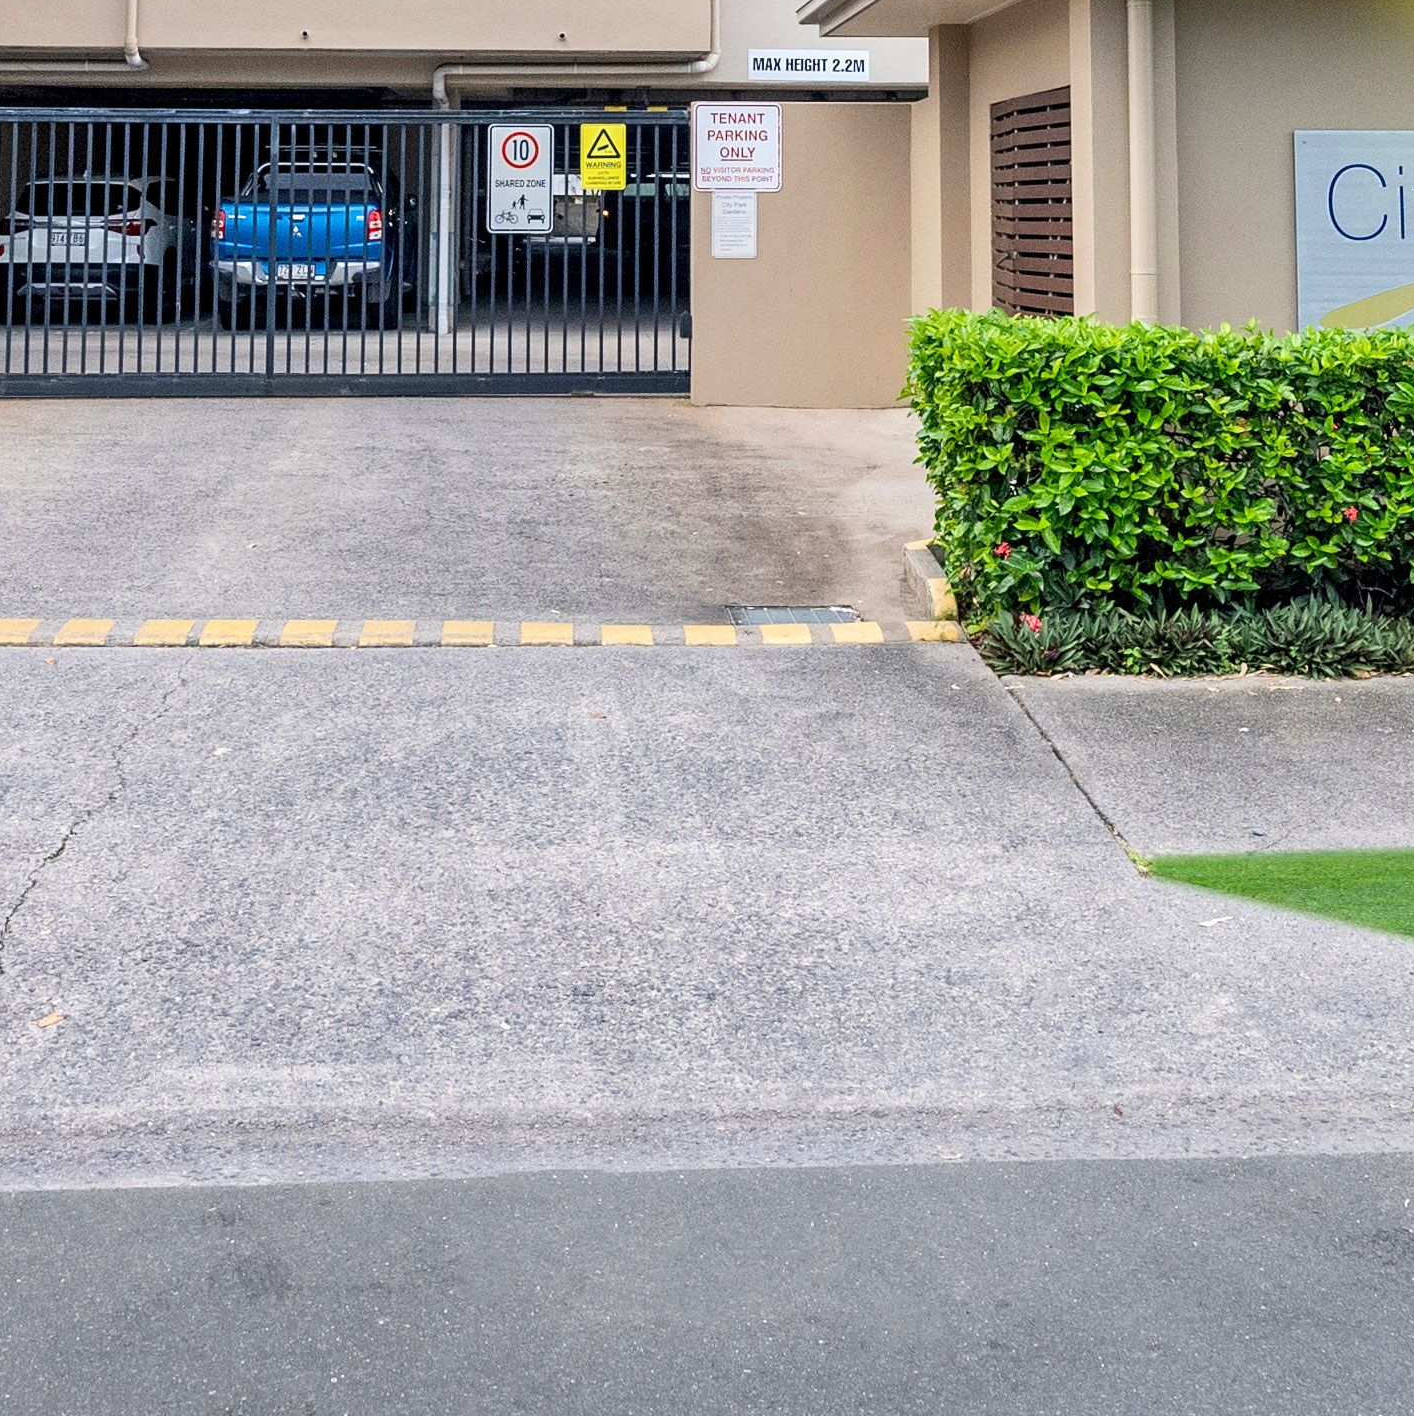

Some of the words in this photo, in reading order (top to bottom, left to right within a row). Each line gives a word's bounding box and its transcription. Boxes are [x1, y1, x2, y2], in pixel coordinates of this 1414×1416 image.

[752, 57, 782, 71] MAX
[785, 58, 828, 72] HEIGHT
[832, 58, 865, 73] 2.2M
[710, 112, 765, 124] TENANT
[707, 129, 768, 142] PARKING
[512, 139, 529, 161] 10
[719, 146, 755, 158] ONLY
[586, 161, 622, 169] WARNING
[494, 179, 525, 188] SHARED
[526, 179, 546, 188] ZONE
